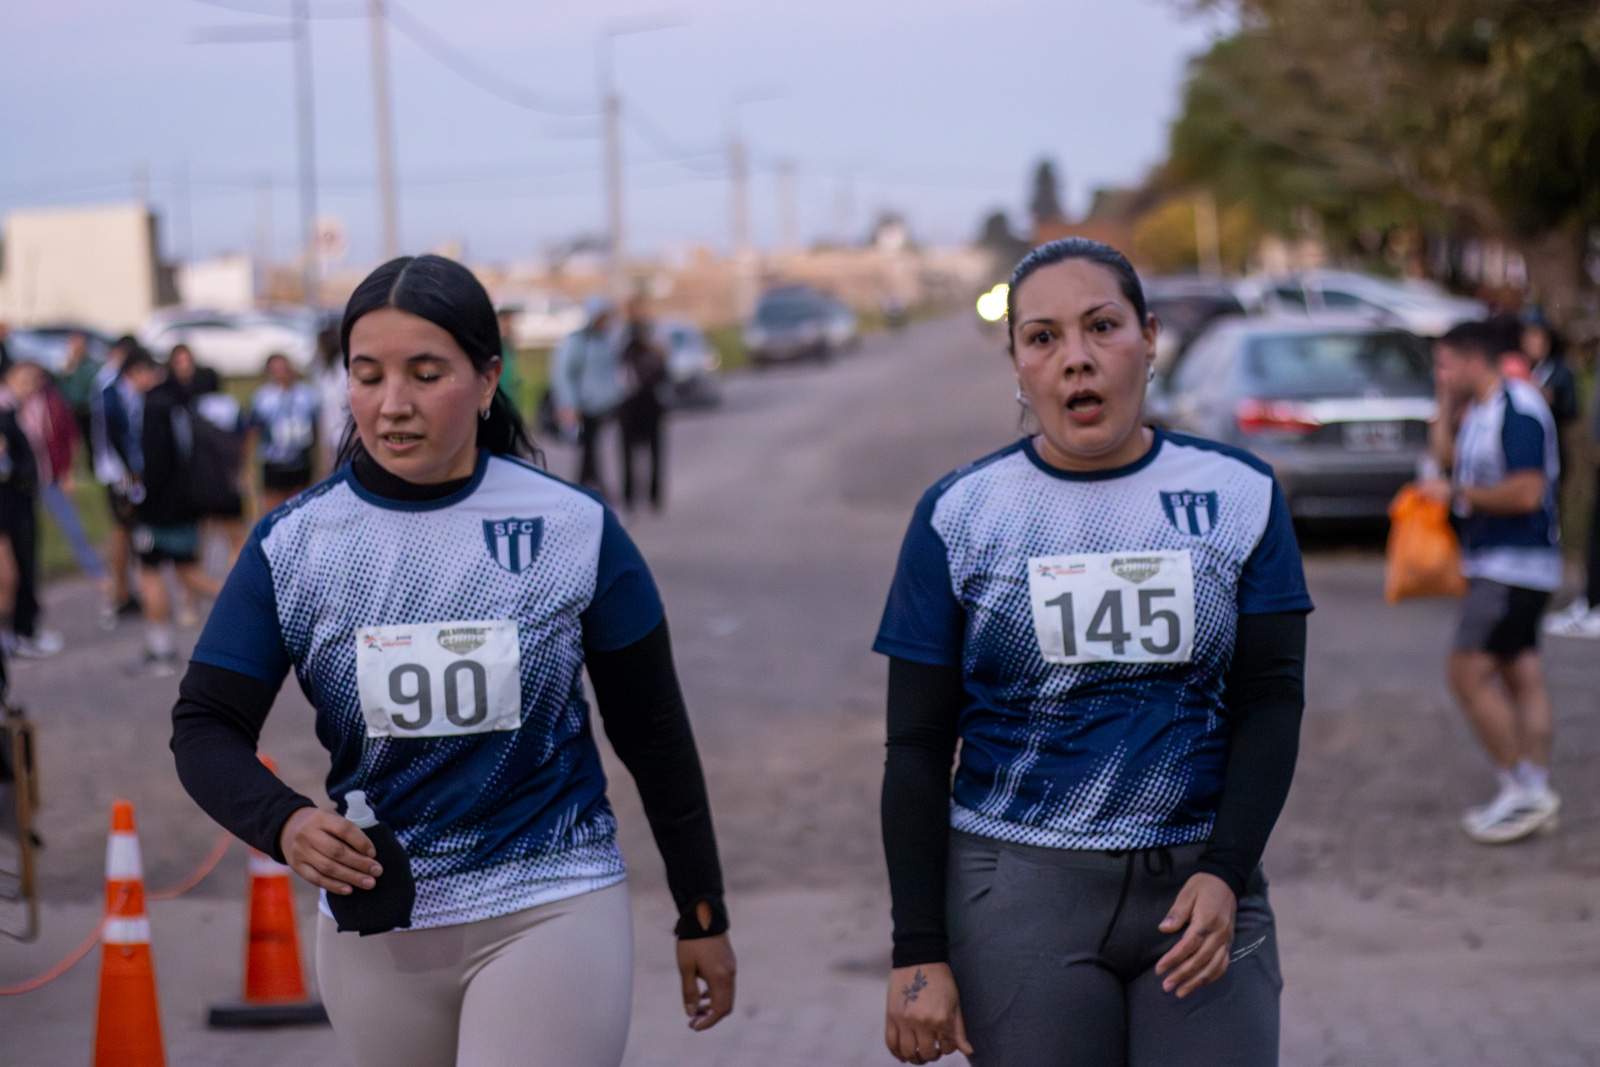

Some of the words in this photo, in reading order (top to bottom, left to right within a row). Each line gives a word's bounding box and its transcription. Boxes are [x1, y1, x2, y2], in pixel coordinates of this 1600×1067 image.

[1170, 494, 1208, 507] SFC
[494, 521, 533, 536] SFC
[1044, 588, 1181, 657] 145
[388, 659, 488, 731] 90
